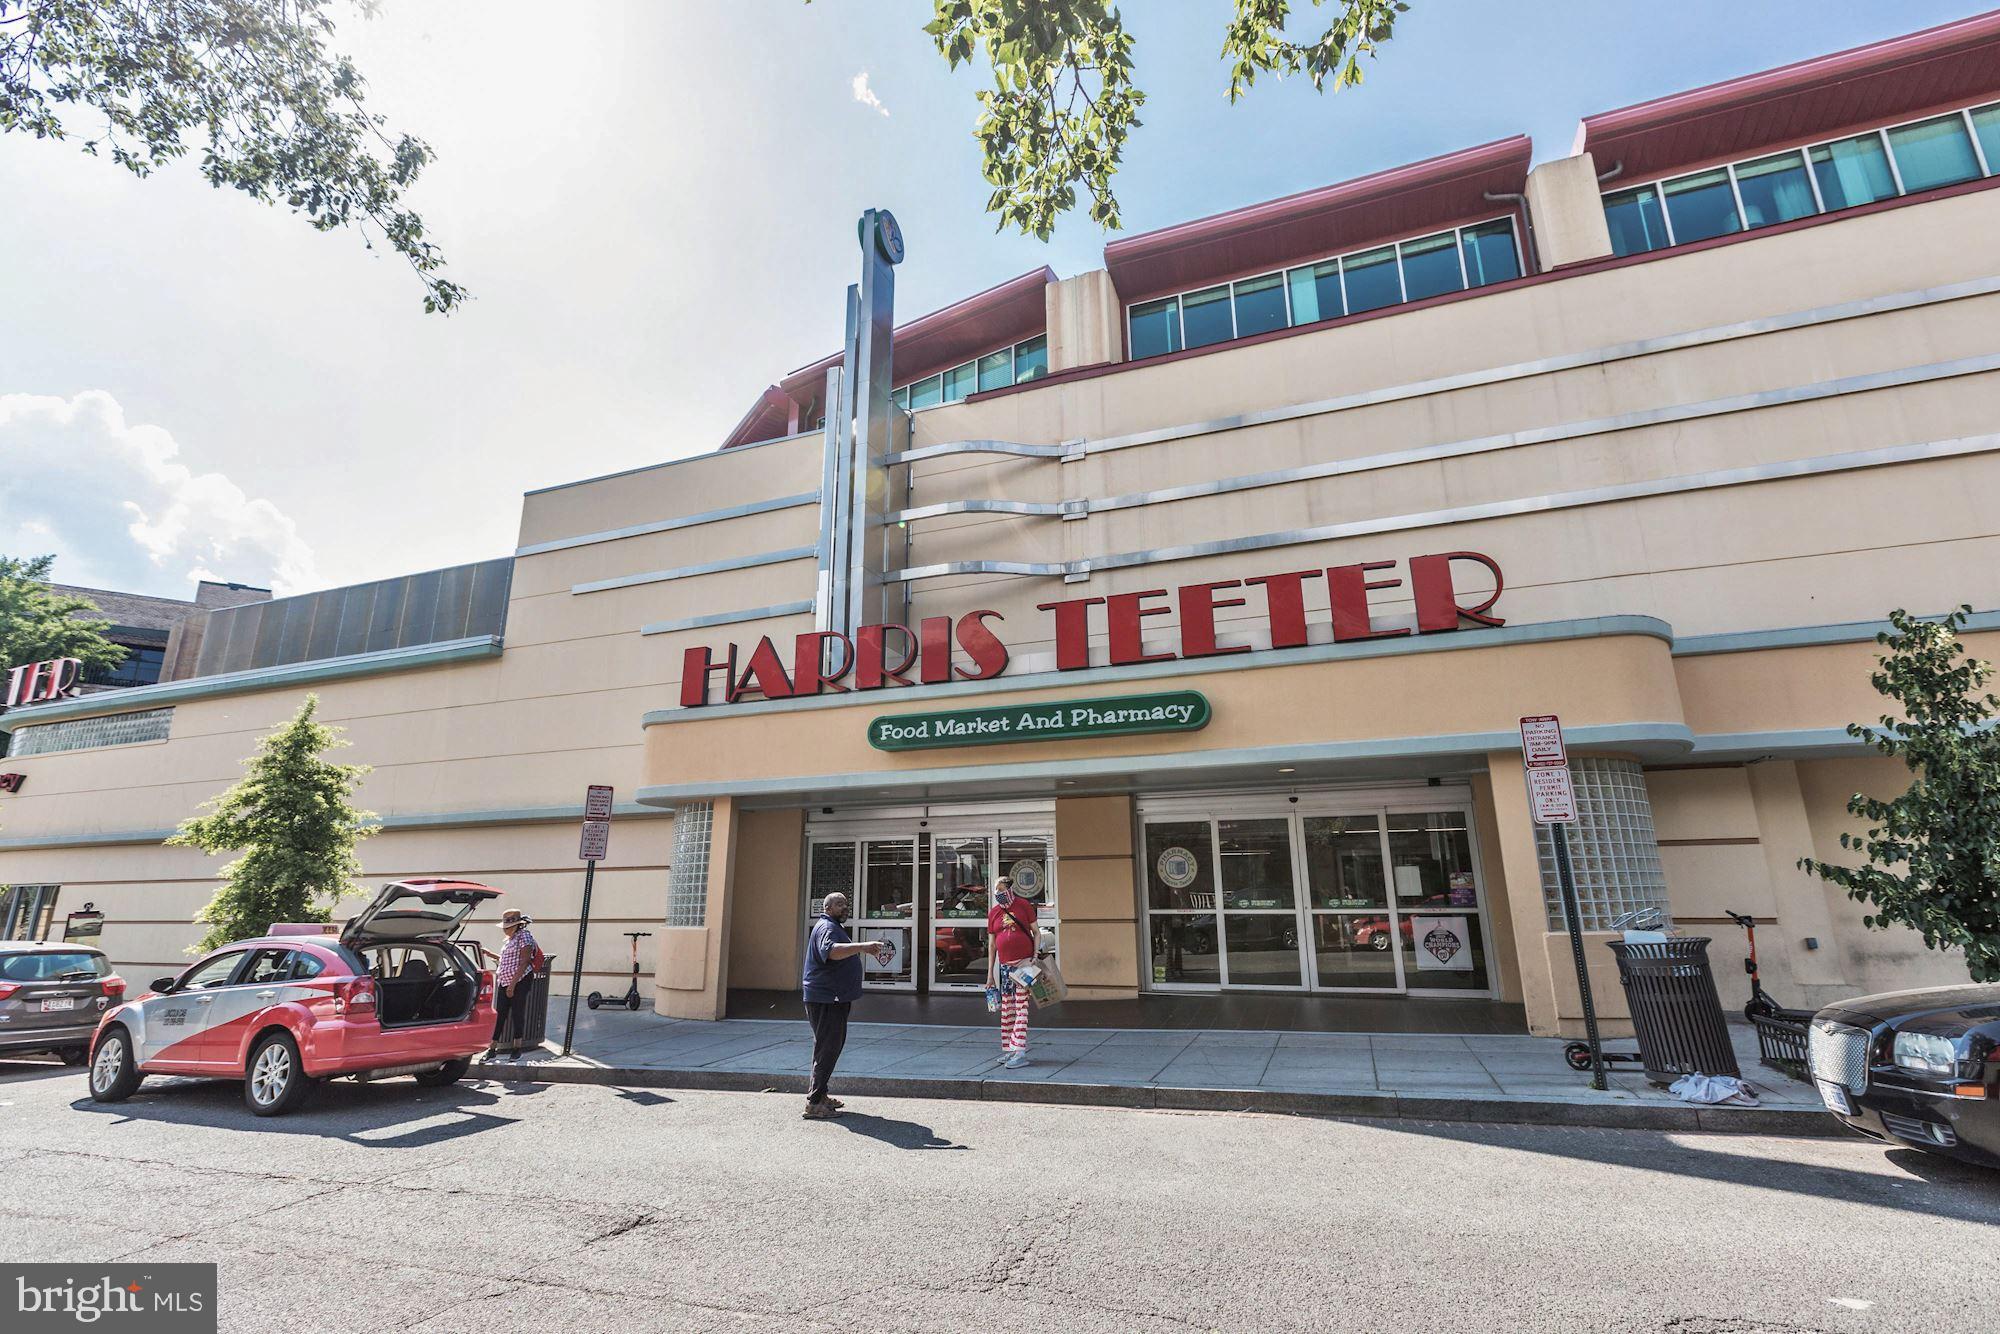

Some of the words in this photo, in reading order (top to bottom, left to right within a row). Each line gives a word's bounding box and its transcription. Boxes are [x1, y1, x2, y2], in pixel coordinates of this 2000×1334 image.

[680, 609, 1009, 708] HARRIS
[1036, 551, 1506, 671] TEETER
[0, 656, 82, 707] TER
[880, 721, 928, 740] Food
[934, 717, 1010, 737] Market
[1016, 710, 1064, 731] And
[1070, 703, 1195, 728] Pharmacy
[1533, 777, 1565, 785] RESIDENT
[1159, 848, 1195, 866] PHARMACY
